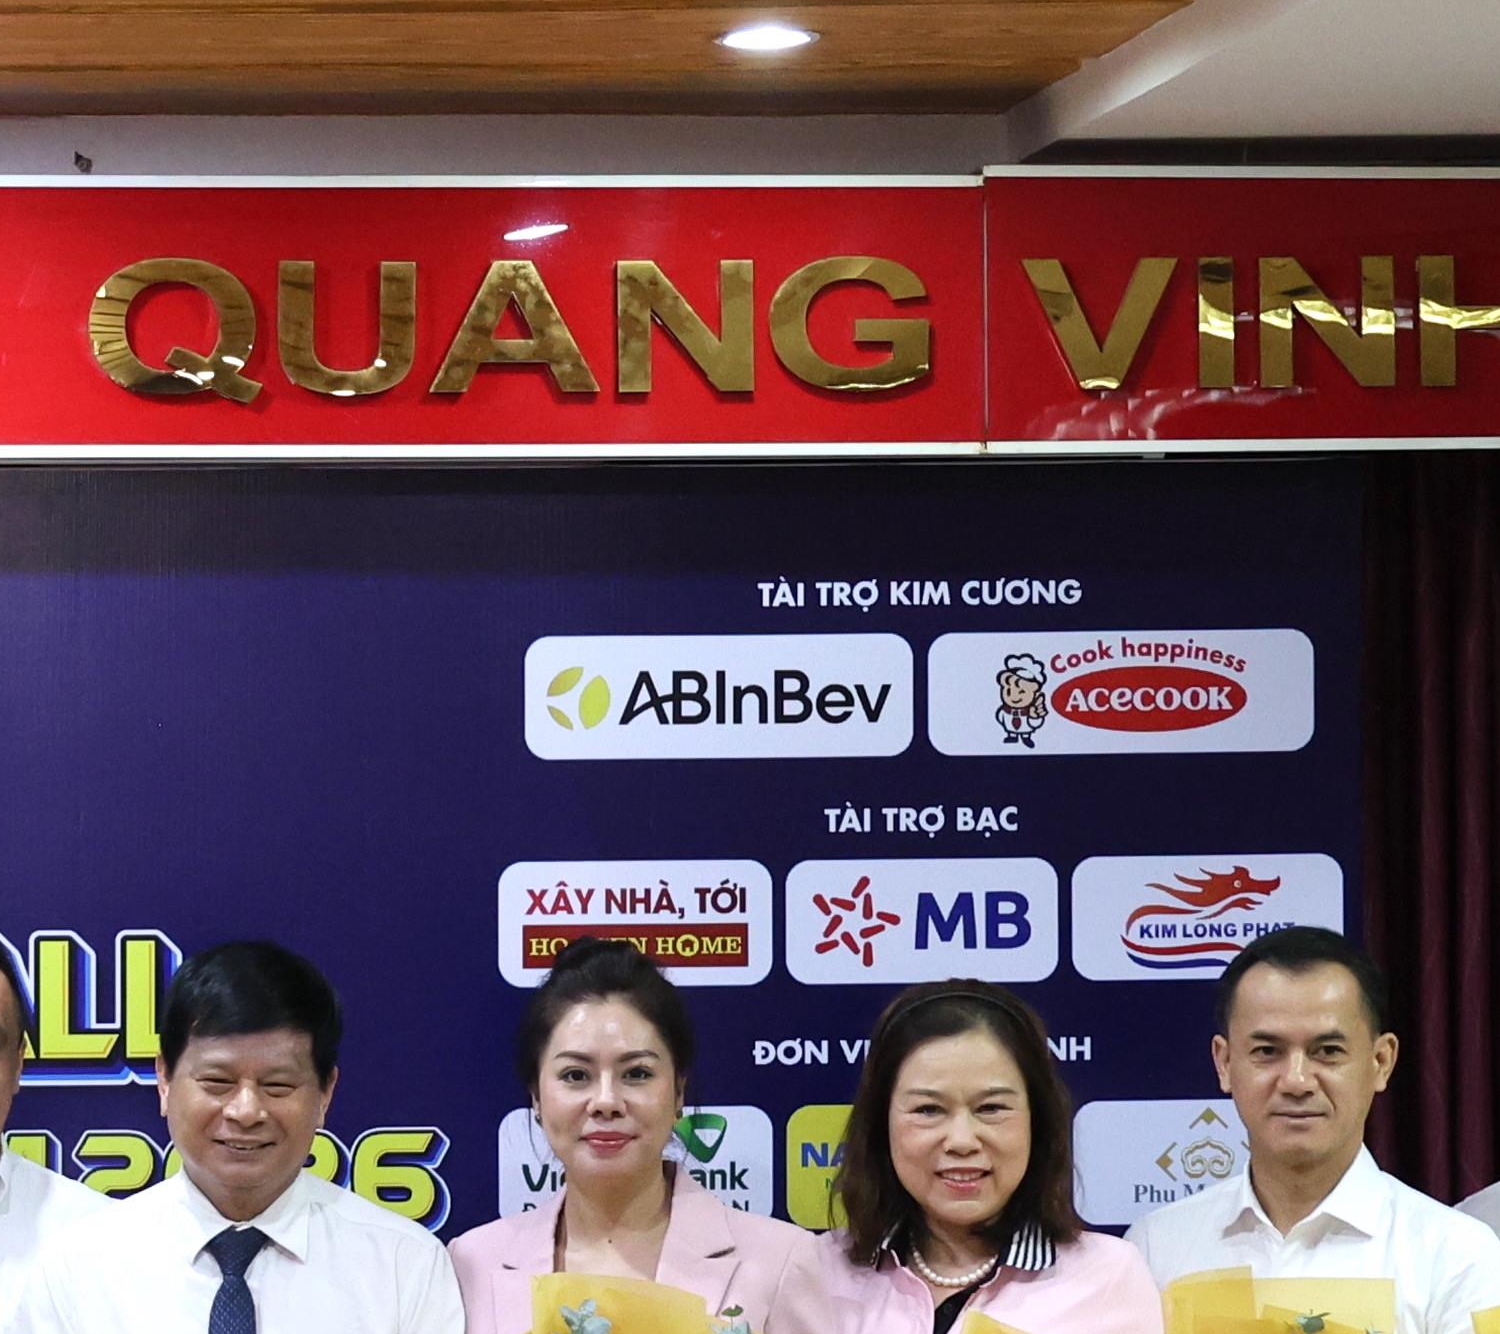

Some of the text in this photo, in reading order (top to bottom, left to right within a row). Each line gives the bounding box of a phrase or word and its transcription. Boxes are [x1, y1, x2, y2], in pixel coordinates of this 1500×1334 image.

[89, 256, 932, 403] QUANG
[757, 575, 1082, 612] TÀI TRỢ KIM CƯƠNG
[1050, 636, 1247, 673] Cook happiness
[619, 670, 892, 725] ABInBev
[824, 801, 1018, 838] TÀI TRỢ BẠC
[526, 879, 746, 919] XÂY NHÀ, TỚI
[915, 891, 1032, 950] MB
[1140, 924, 1177, 939] KIM
[1182, 922, 1237, 938] LONG
[656, 934, 741, 957] HOME
[753, 1038, 828, 1065] ĐƠN
[1133, 1184, 1176, 1203] Phu
